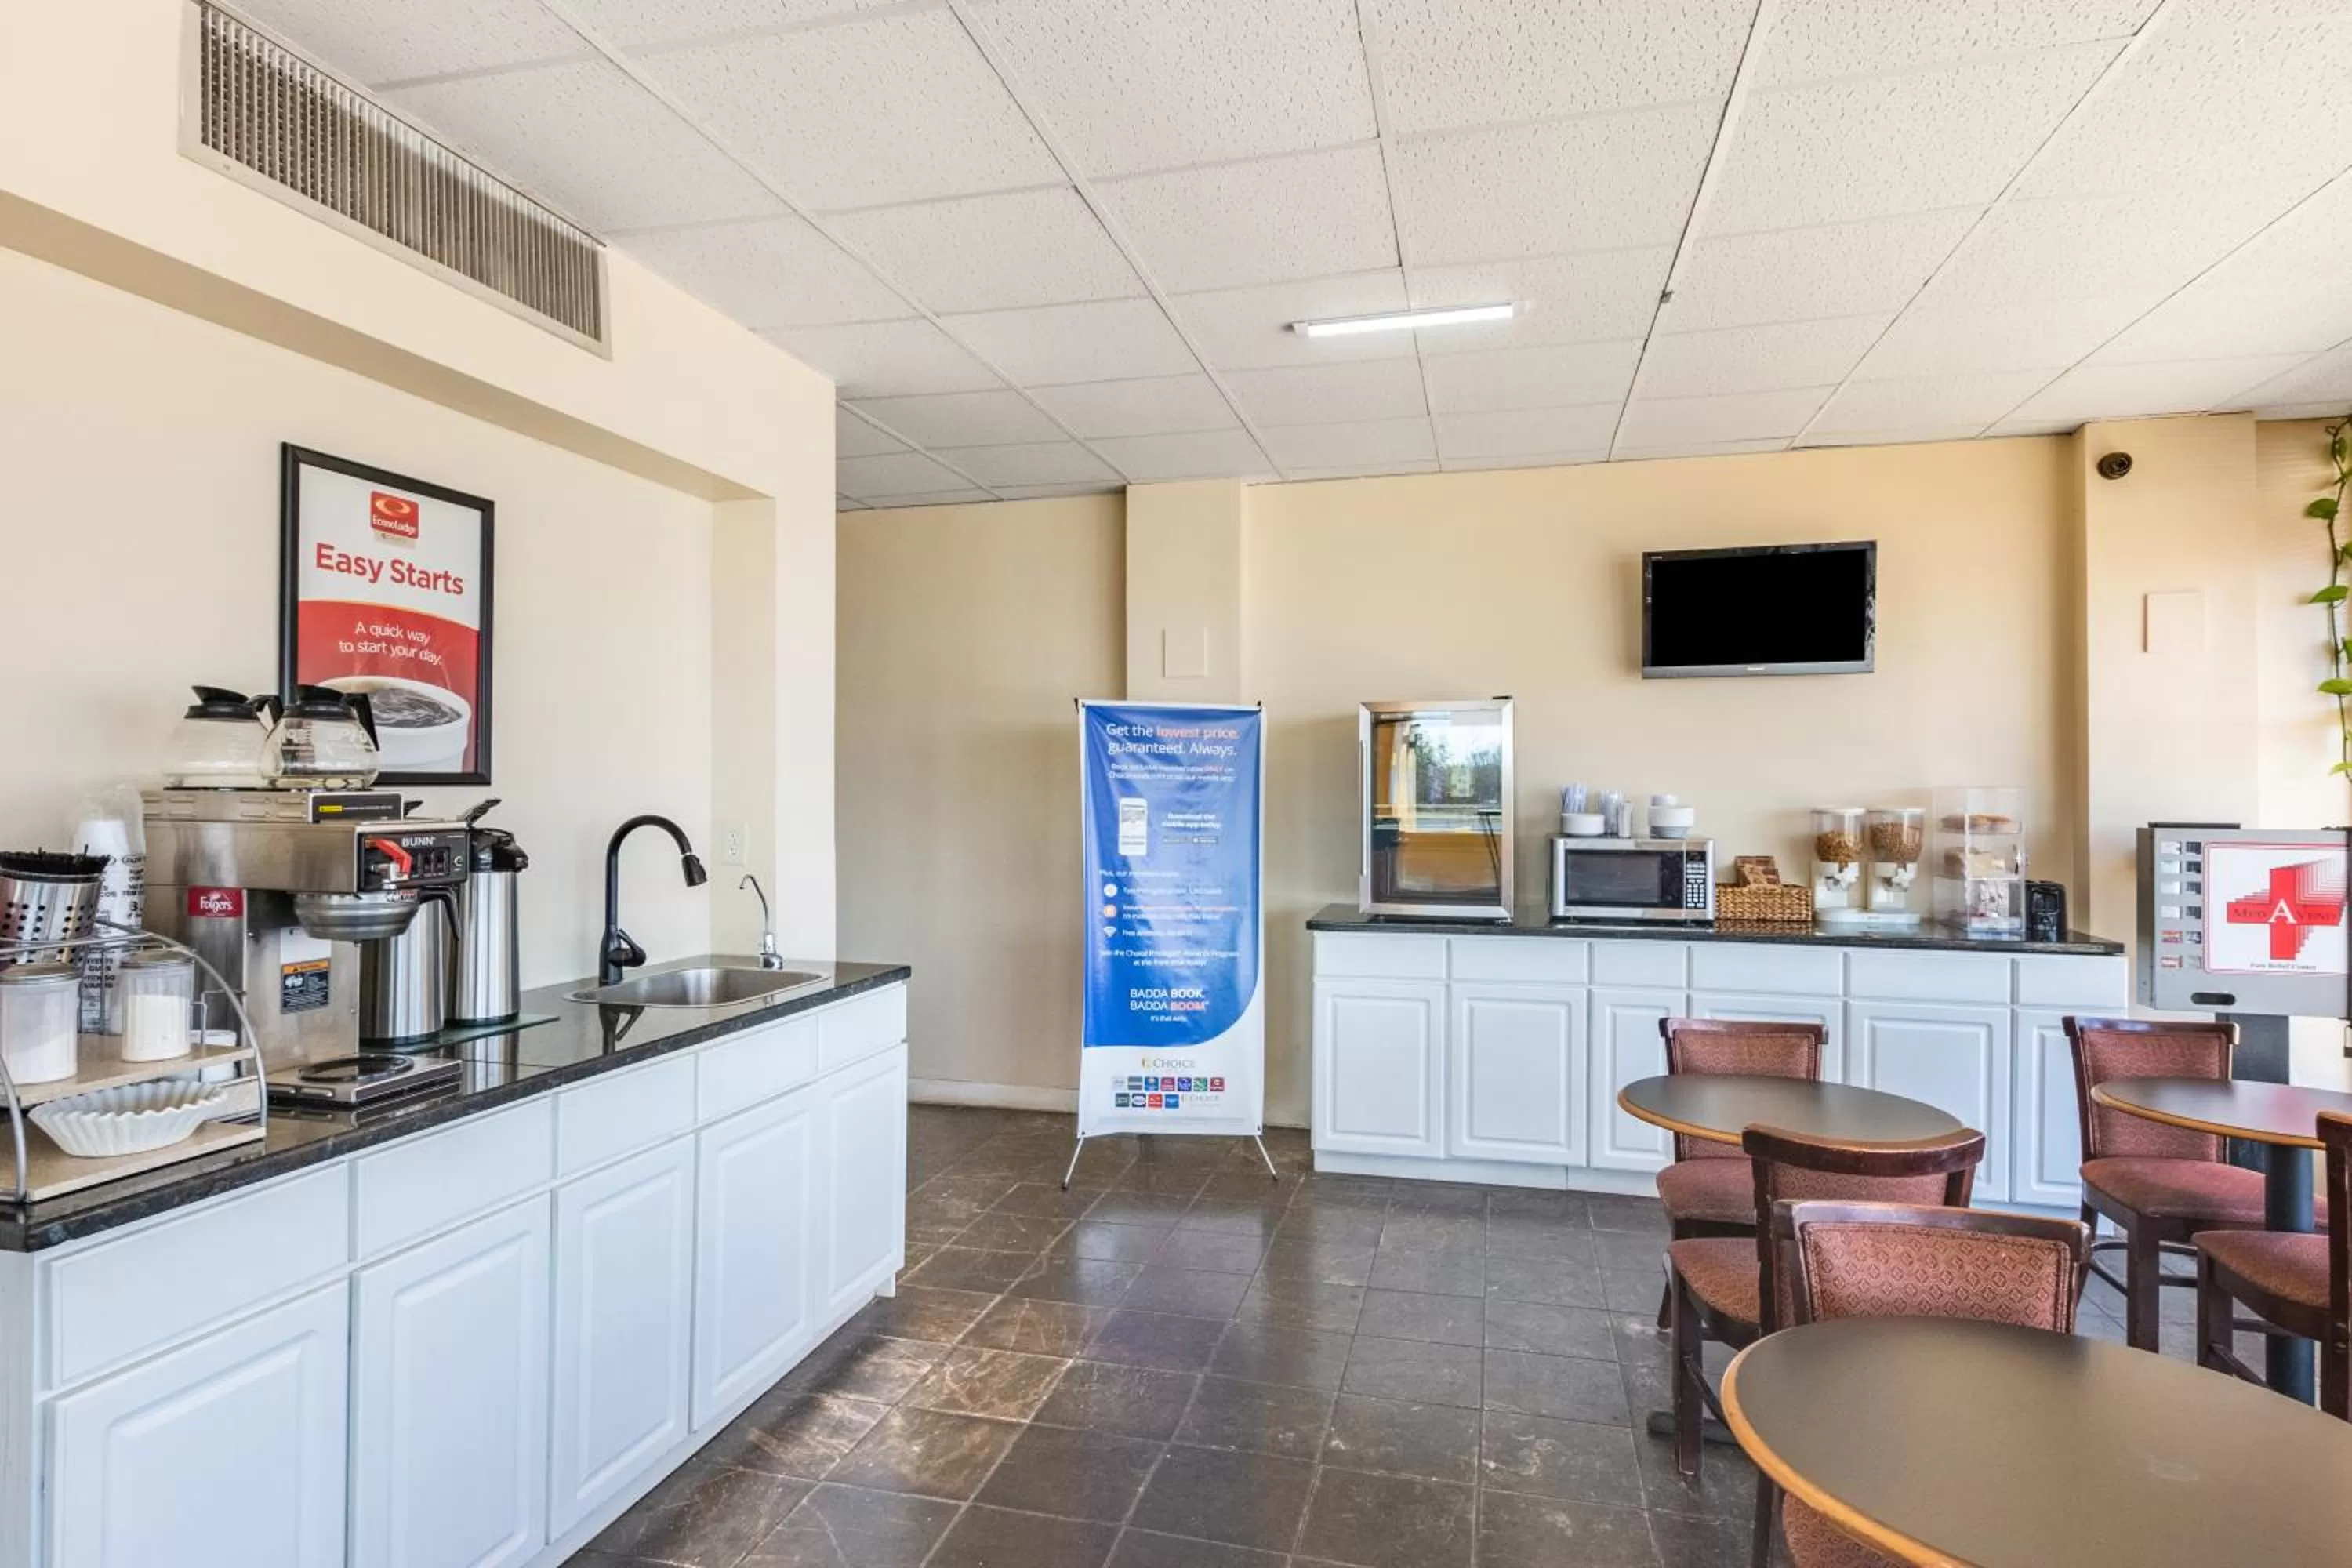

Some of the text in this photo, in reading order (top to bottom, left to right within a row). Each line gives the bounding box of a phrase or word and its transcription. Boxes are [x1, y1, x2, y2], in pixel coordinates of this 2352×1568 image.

[316, 543, 464, 595] Easy Starts
[354, 621, 430, 646] A quick way
[339, 640, 444, 666] to start your day.
[1106, 724, 1130, 736] Get
[1132, 724, 1153, 737] the
[1156, 725, 1199, 738] lowest
[1107, 742, 1238, 758] guaranteed. Always.
[401, 837, 434, 847] BUNN
[1130, 989, 1205, 998] BADDA BOOK.
[1130, 1000, 1168, 1011] BADDA
